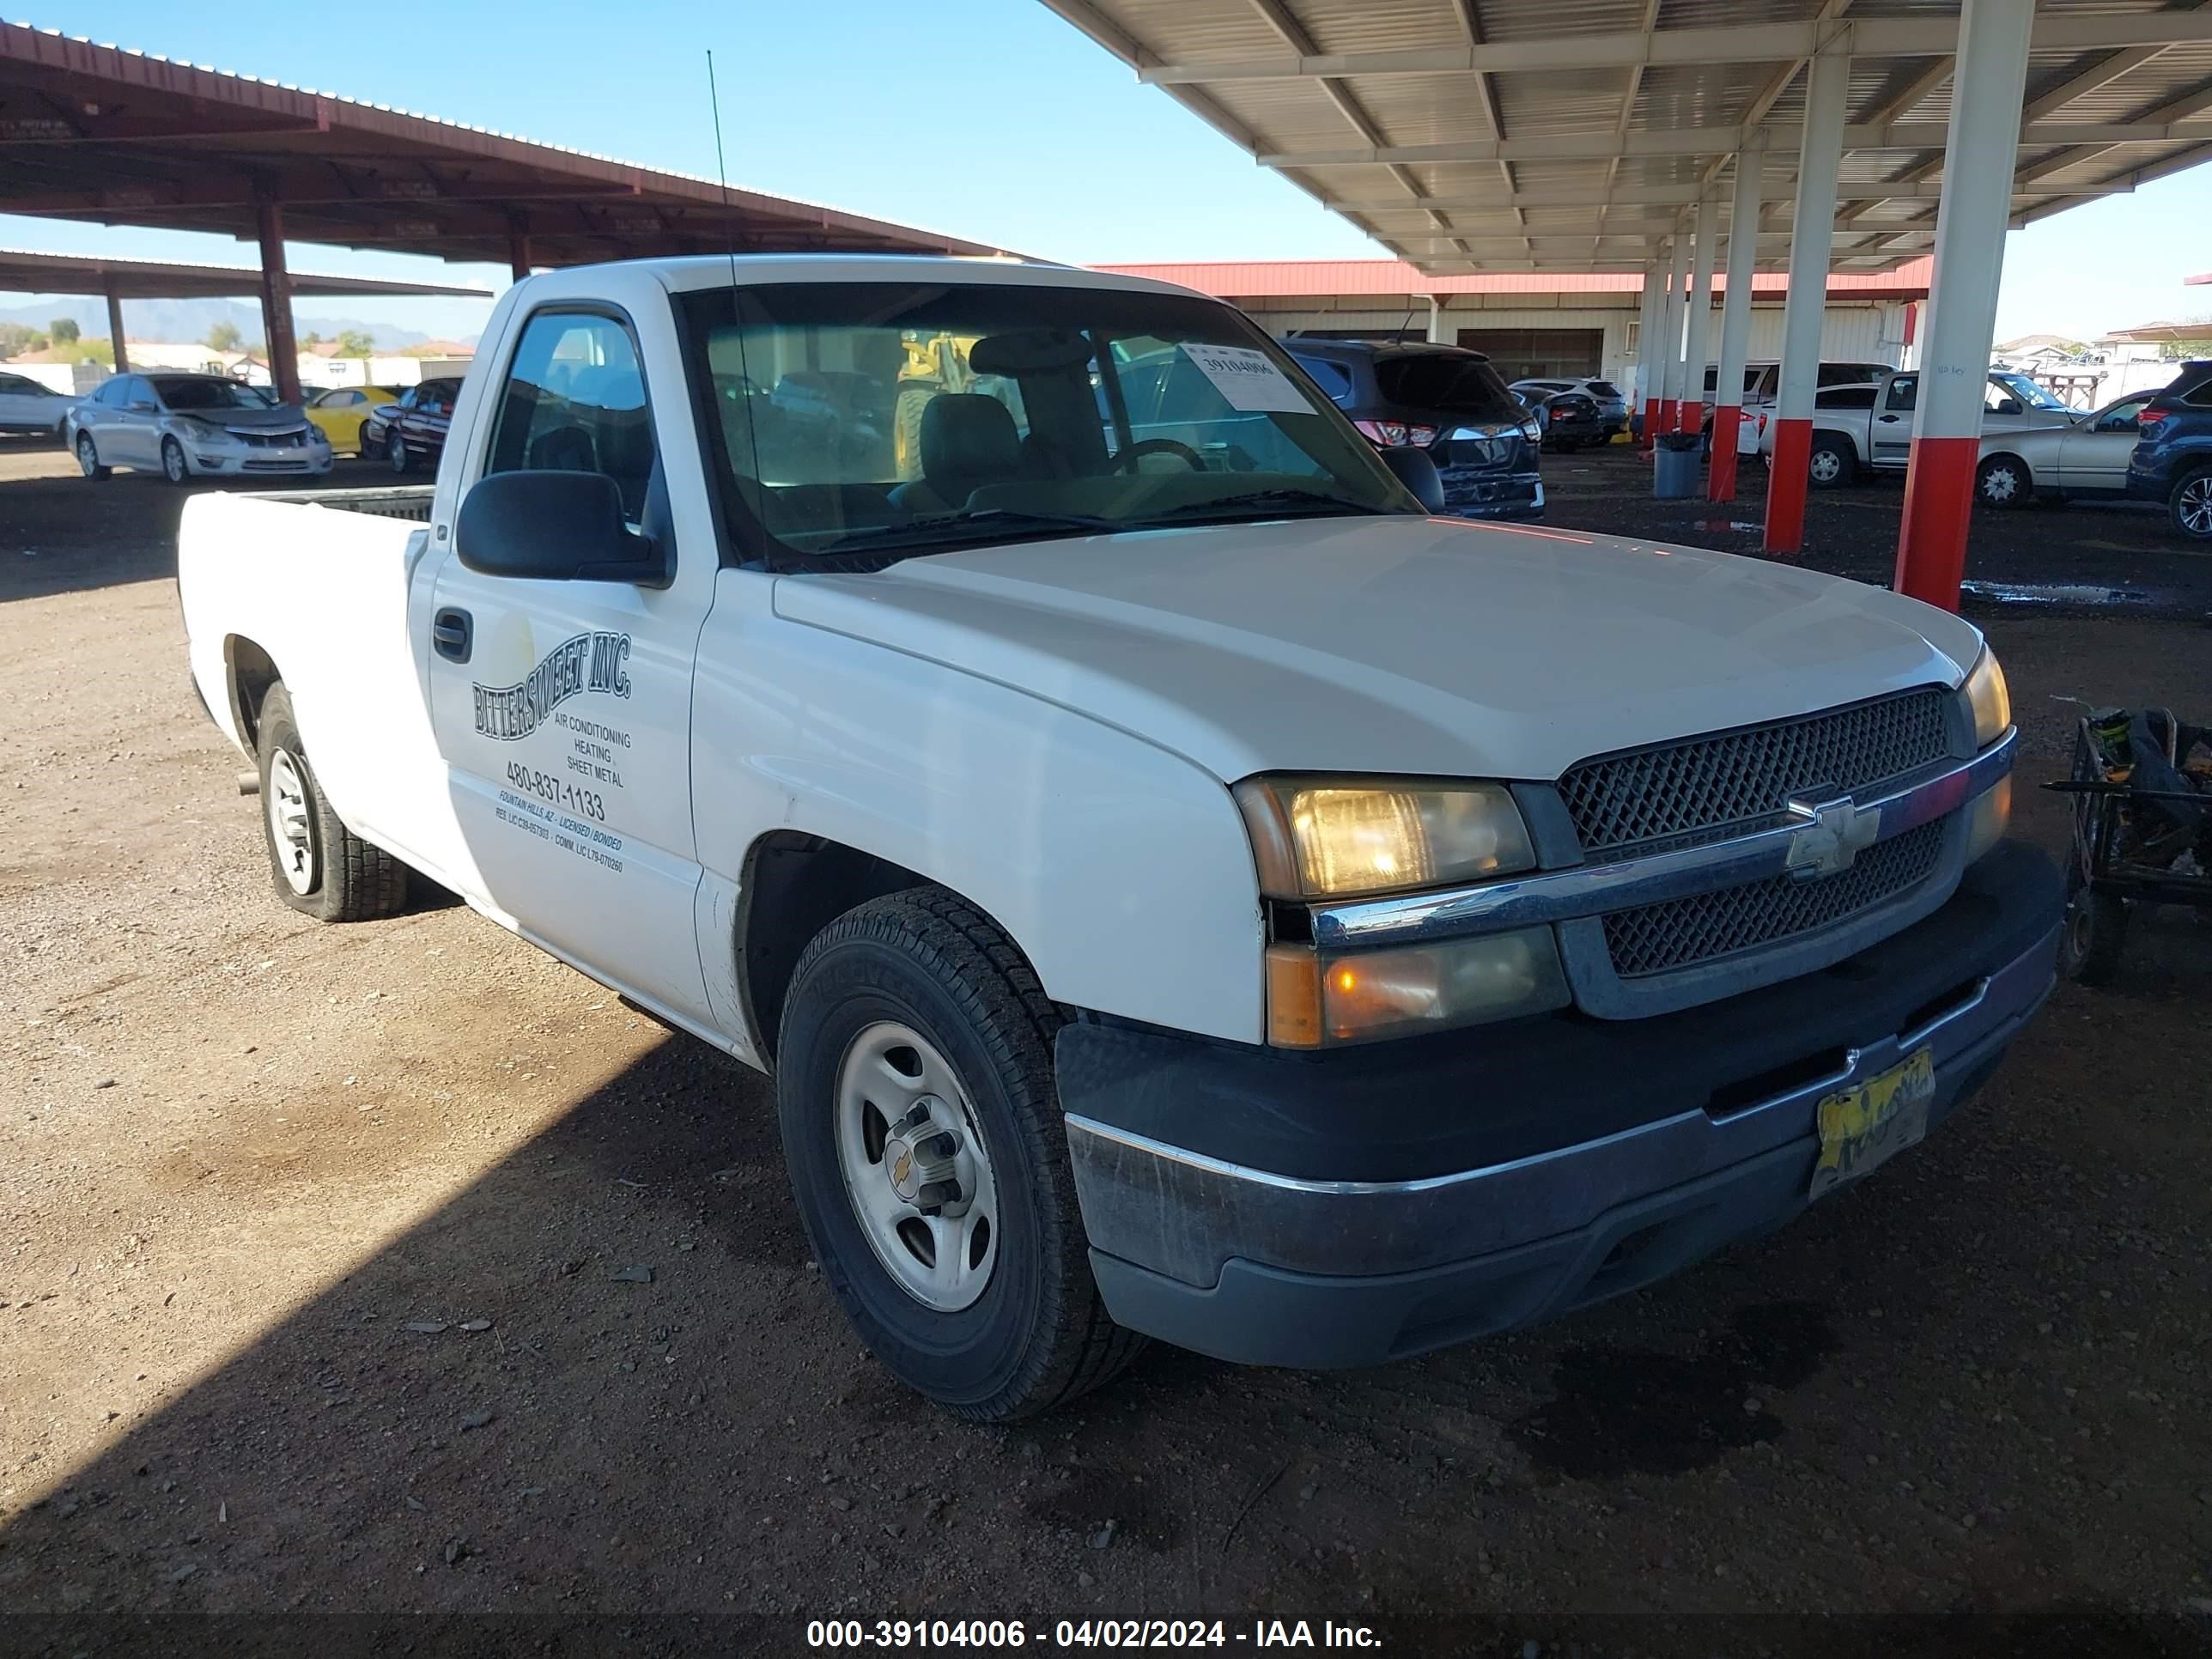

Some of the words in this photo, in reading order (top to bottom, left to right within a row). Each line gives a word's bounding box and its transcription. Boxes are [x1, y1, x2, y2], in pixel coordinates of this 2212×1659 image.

[1202, 358, 1274, 376] 39104006
[472, 632, 591, 741] BITTERSWEET
[588, 631, 632, 700] INC.
[555, 712, 568, 729] AIR
[569, 716, 631, 749] CONDITIONING
[574, 738, 611, 763] HEATING
[567, 756, 592, 777] SHEET
[595, 765, 623, 788] METAL
[507, 760, 605, 822] 480-837-1133
[500, 790, 526, 811] FOUNTAIN
[545, 810, 556, 823] AZ
[560, 816, 591, 836] LICENSED
[593, 830, 622, 851] BONDED
